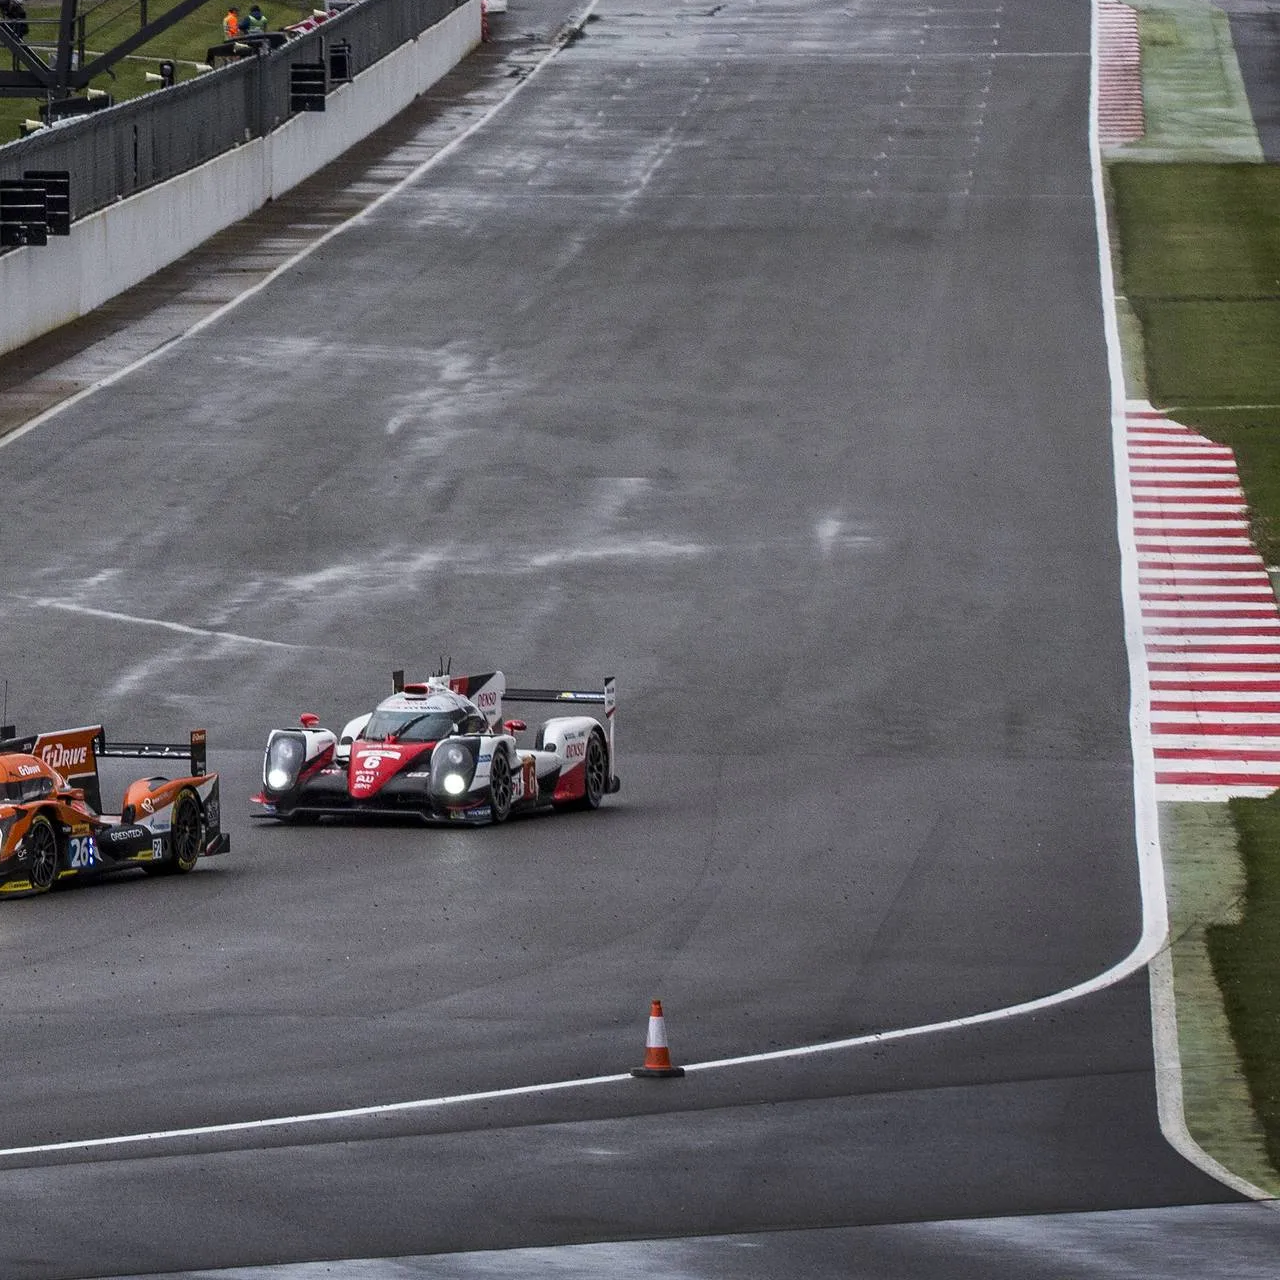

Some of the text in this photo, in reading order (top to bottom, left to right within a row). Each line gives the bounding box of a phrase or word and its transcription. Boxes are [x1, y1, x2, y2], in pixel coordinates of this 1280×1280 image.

[477, 692, 497, 707] DENSO
[565, 742, 585, 758] DENSO
[363, 756, 382, 769] 6
[110, 828, 144, 841] GREENTECH
[71, 837, 88, 868] 26
[153, 840, 161, 858] P2
